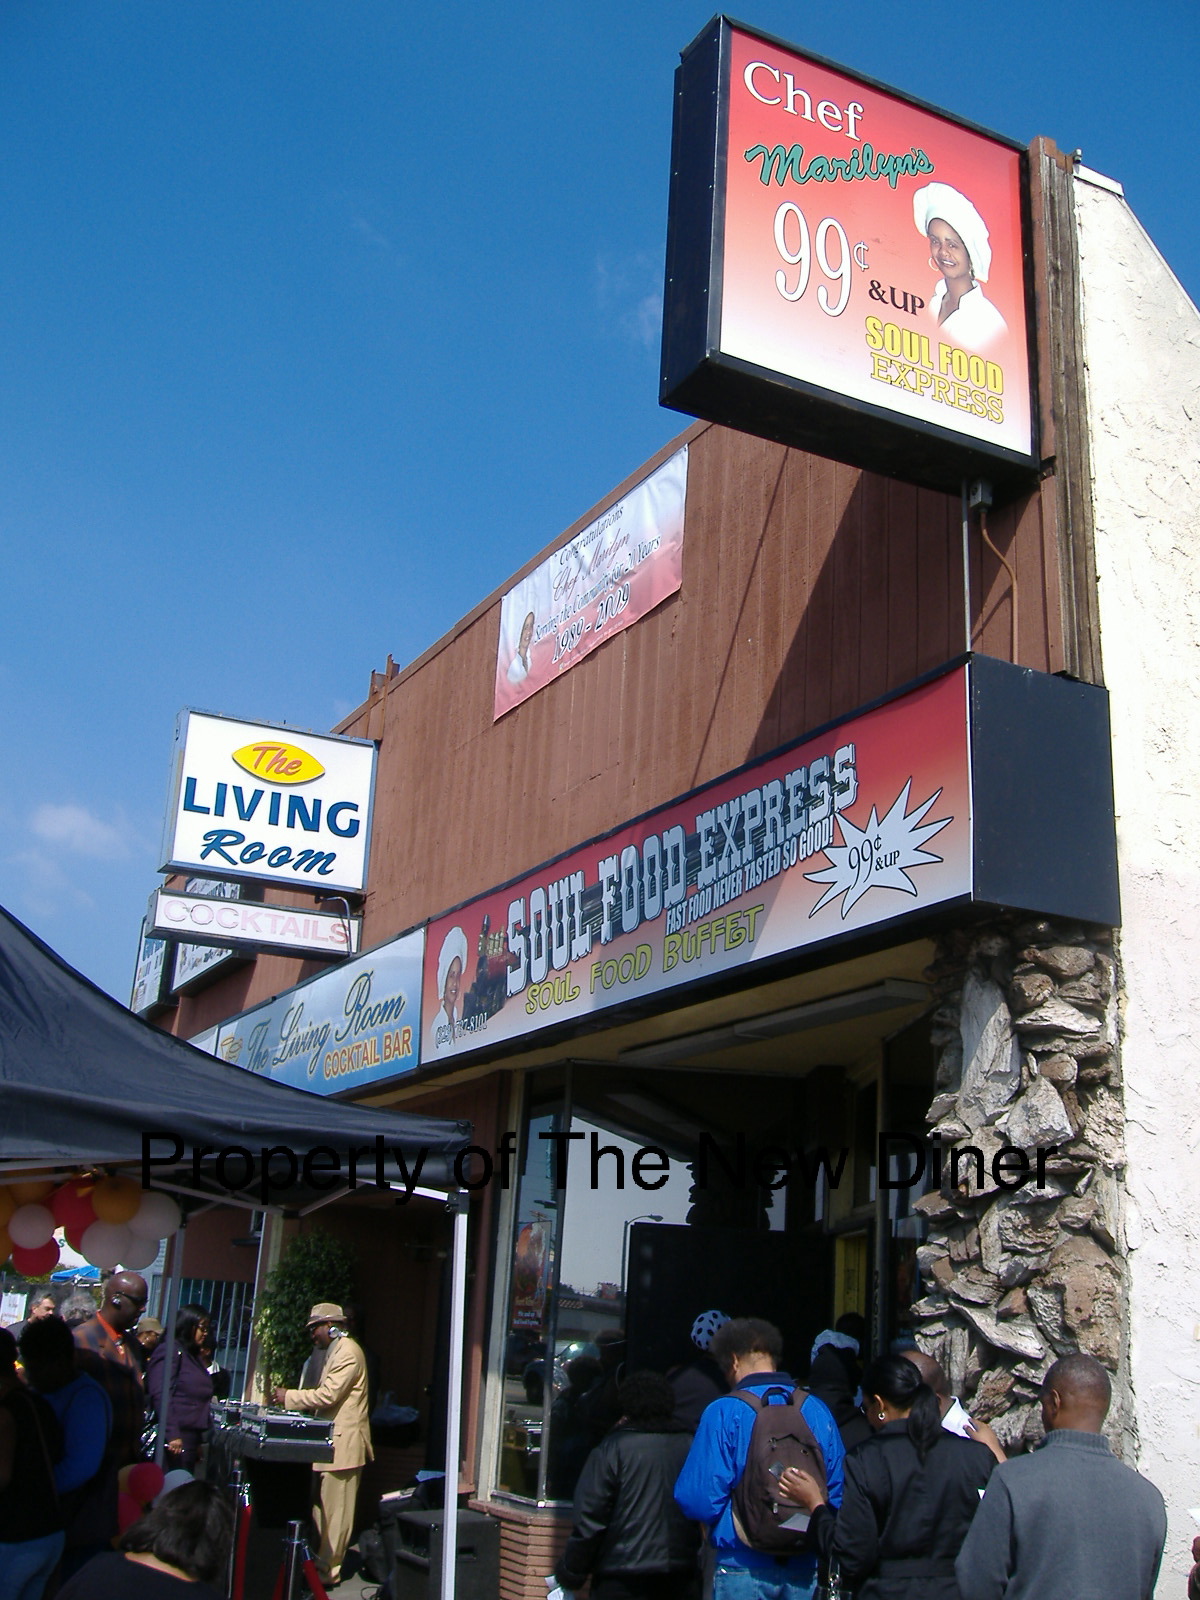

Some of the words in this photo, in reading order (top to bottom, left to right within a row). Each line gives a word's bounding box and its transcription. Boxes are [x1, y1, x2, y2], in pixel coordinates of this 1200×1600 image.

[743, 61, 864, 141] Chef
[743, 143, 935, 189] Marilyn's
[865, 315, 934, 370] SOUL
[939, 342, 1004, 395] FOOD
[871, 352, 1004, 424] EXPRESS
[559, 505, 624, 566] Congratulations
[534, 612, 558, 643] Serving
[559, 602, 572, 623] the
[608, 561, 623, 588] for
[637, 536, 661, 563] Years
[553, 556, 584, 601] Chef
[595, 582, 630, 631] 2009
[252, 745, 302, 776] The
[183, 776, 360, 838] LIVING
[200, 828, 338, 876] Room
[505, 870, 593, 997] SOUL
[598, 824, 688, 946] FOOD
[695, 743, 859, 891] EXPRESS
[666, 902, 688, 936] FAST
[688, 889, 712, 925] FOOD
[713, 872, 743, 910] NEVER
[744, 847, 782, 892] TASTED
[783, 836, 797, 871] SO
[799, 814, 834, 862] GOOD!
[163, 899, 350, 945] COCKTAILS
[525, 971, 580, 1015] SOUL
[590, 943, 652, 994] FOOD
[663, 904, 765, 973] BUFFET
[247, 1019, 271, 1071] The
[272, 1002, 331, 1074] Living
[335, 970, 406, 1042] Room
[324, 1038, 380, 1079] COCKTAIL
[383, 1027, 412, 1062] BAR
